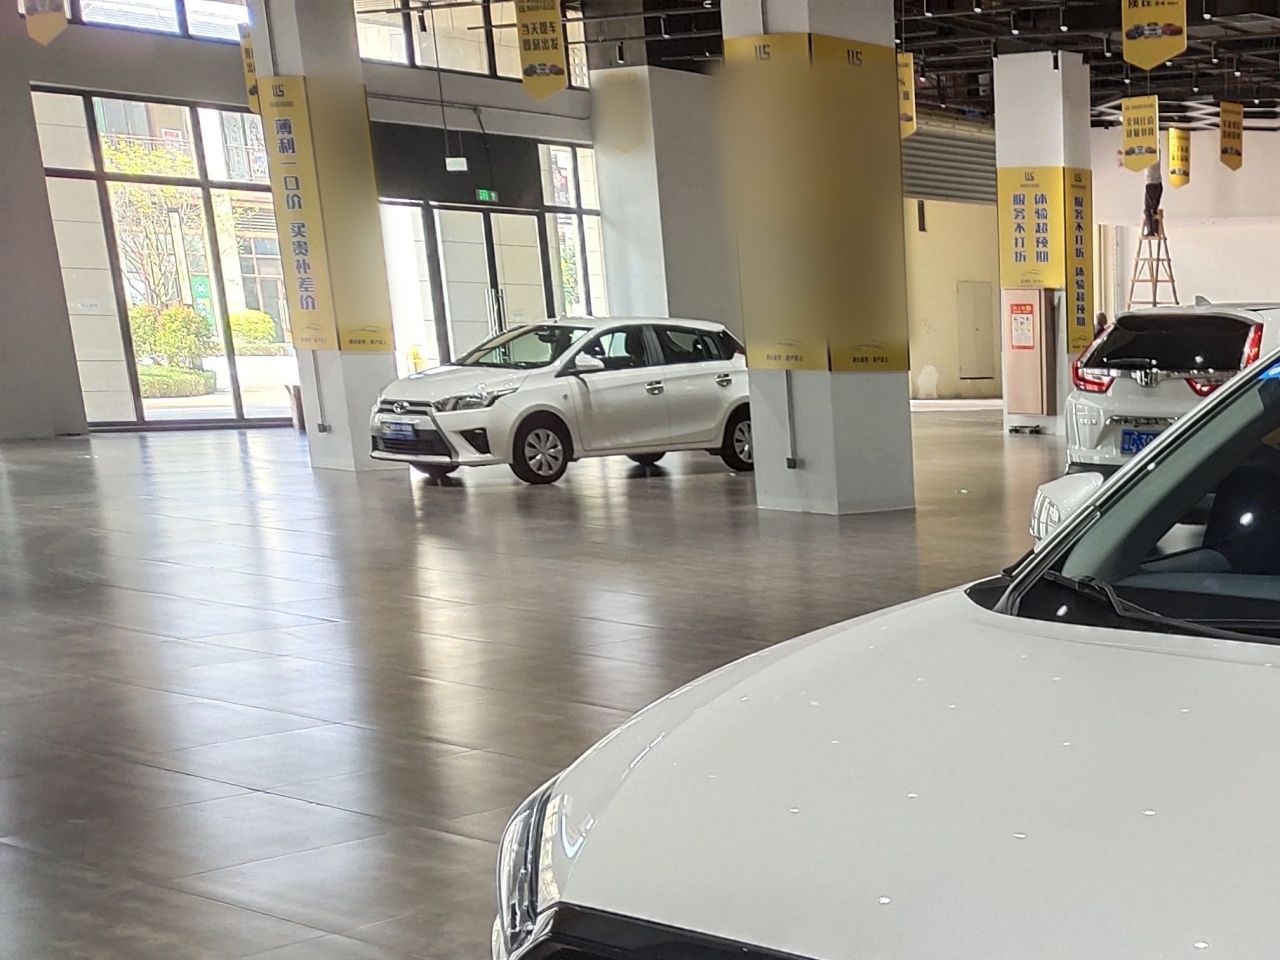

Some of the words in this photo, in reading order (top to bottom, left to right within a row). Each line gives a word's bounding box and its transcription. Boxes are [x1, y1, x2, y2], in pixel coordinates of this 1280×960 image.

[275, 118, 303, 210] 薄利一口价
[290, 222, 316, 311] 买贵补差价
[1013, 193, 1027, 262] 服务不打折
[1034, 193, 1049, 262] 体验超预期
[1074, 196, 1085, 258] 服务不打折
[1075, 266, 1086, 327] 体验超预期
